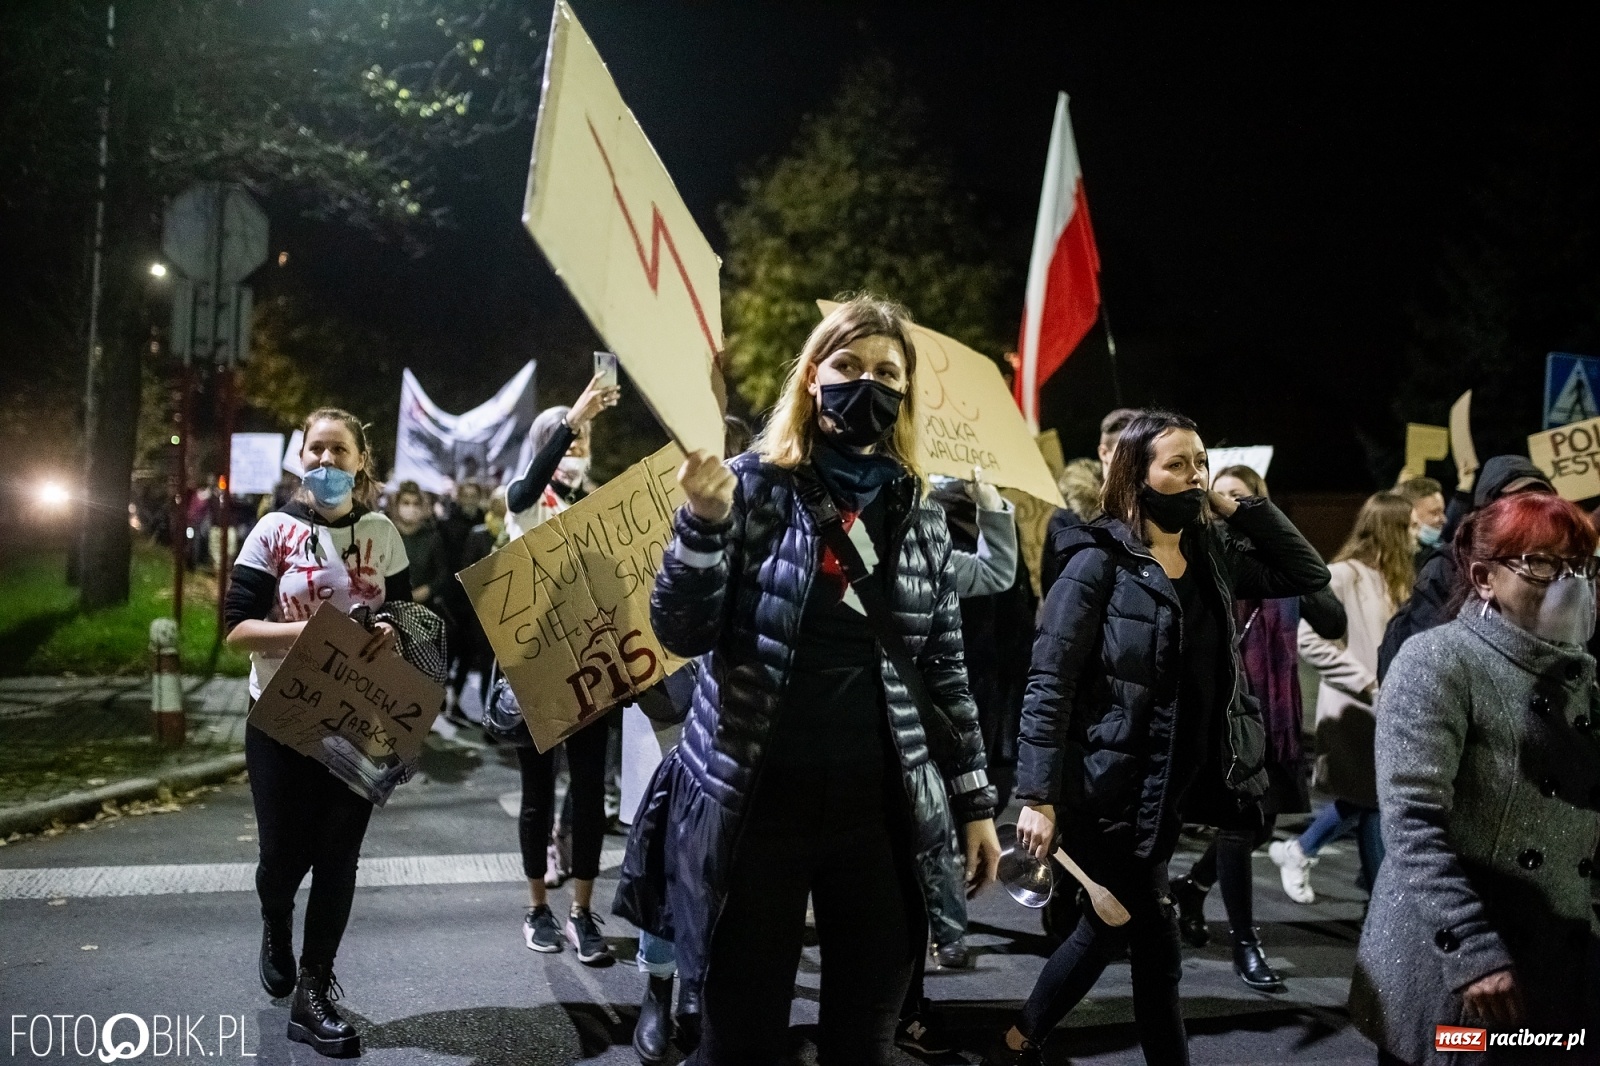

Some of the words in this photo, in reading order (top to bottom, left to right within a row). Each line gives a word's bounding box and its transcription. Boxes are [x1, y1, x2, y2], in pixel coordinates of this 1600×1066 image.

[482, 465, 677, 626] ZAJMIJCIE
[279, 677, 323, 708] DLA
[320, 700, 399, 753] JARKA
[320, 640, 397, 715] TUPOLEW
[566, 629, 657, 721] PiS
